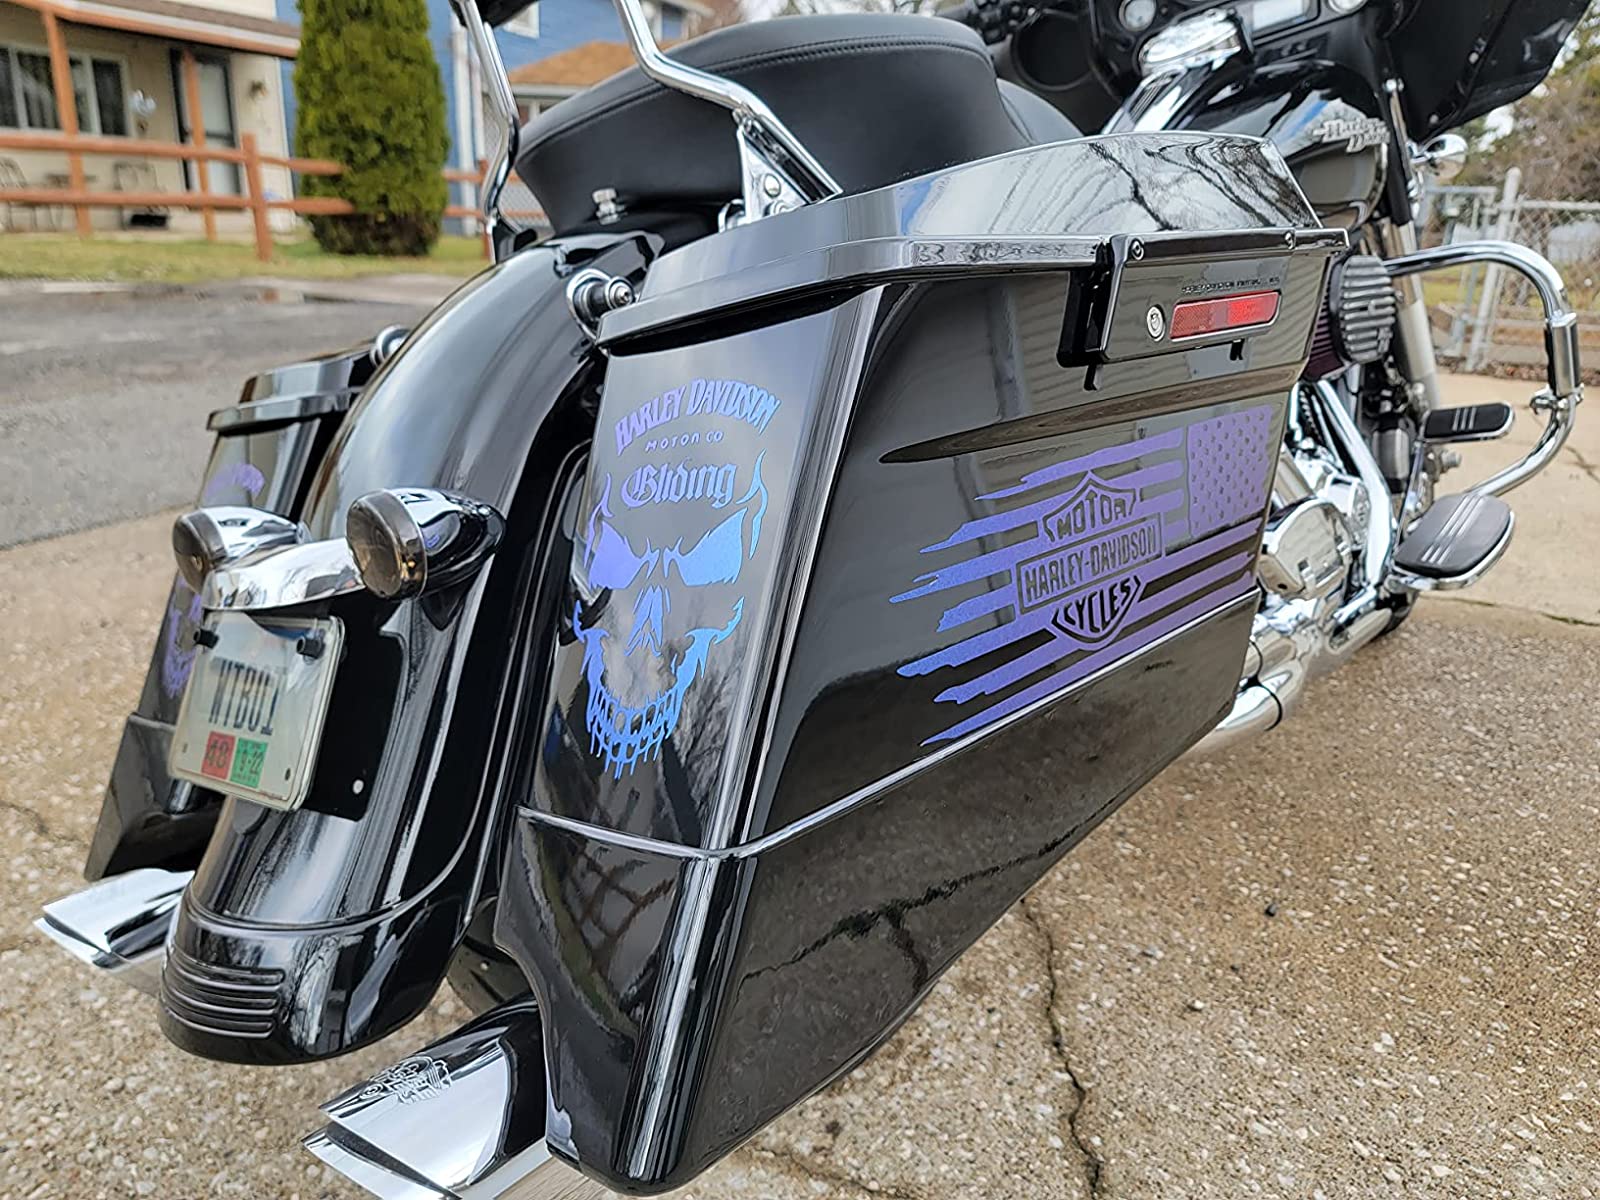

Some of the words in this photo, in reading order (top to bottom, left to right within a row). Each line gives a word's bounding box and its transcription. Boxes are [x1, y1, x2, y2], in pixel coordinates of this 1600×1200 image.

[615, 385, 687, 456] HARLEY
[687, 378, 781, 434] DAVIDSON
[706, 430, 724, 443] CO
[1056, 488, 1126, 540] MOTOR
[1024, 523, 1157, 603] HARLEY-DAVIDSON
[1063, 576, 1131, 634] CYCLES
